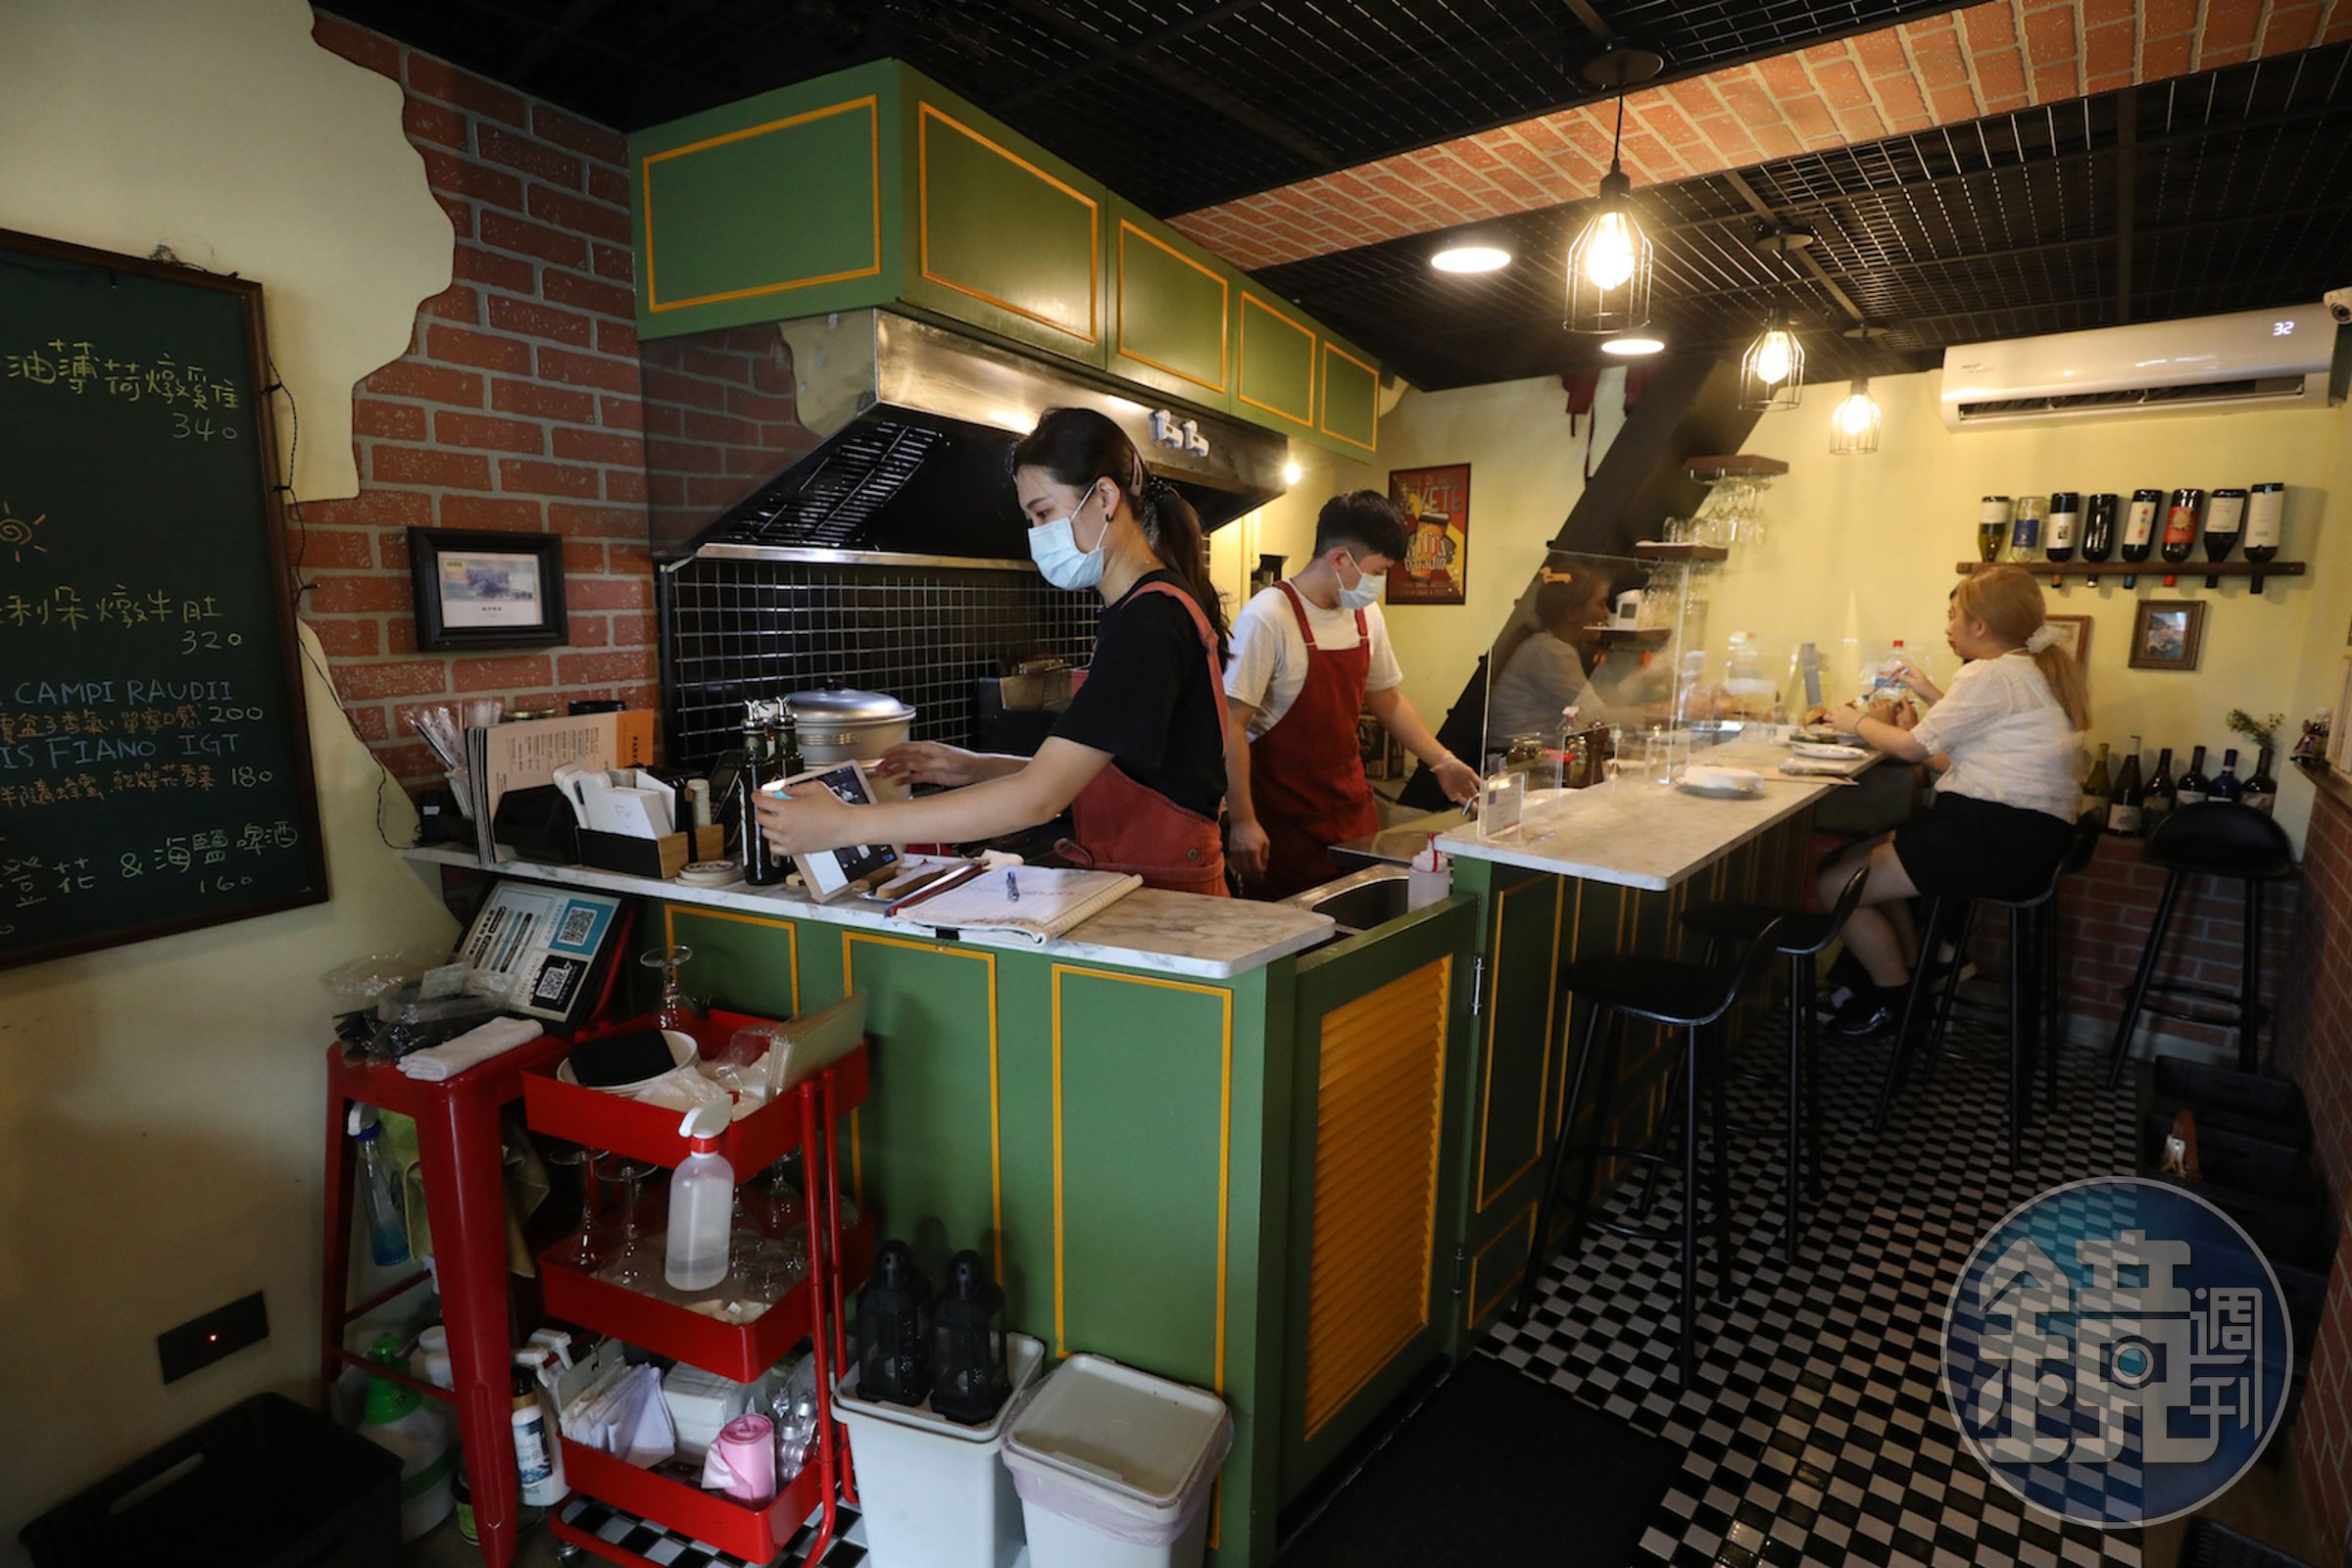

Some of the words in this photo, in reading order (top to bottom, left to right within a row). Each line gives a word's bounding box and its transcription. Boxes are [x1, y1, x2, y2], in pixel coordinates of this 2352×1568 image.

[2273, 320, 2295, 336] 32
[172, 413, 238, 441] 340
[0, 584, 222, 630] 利朵燉牛肚
[181, 630, 242, 655] 320
[15, 681, 116, 706] CAMPI
[126, 680, 232, 705] RAUDII
[208, 706, 264, 723] 200
[46, 736, 157, 769] FIANO
[178, 734, 239, 757] IGT
[230, 766, 272, 788] 180
[120, 853, 144, 878] &
[199, 875, 254, 894] 160
